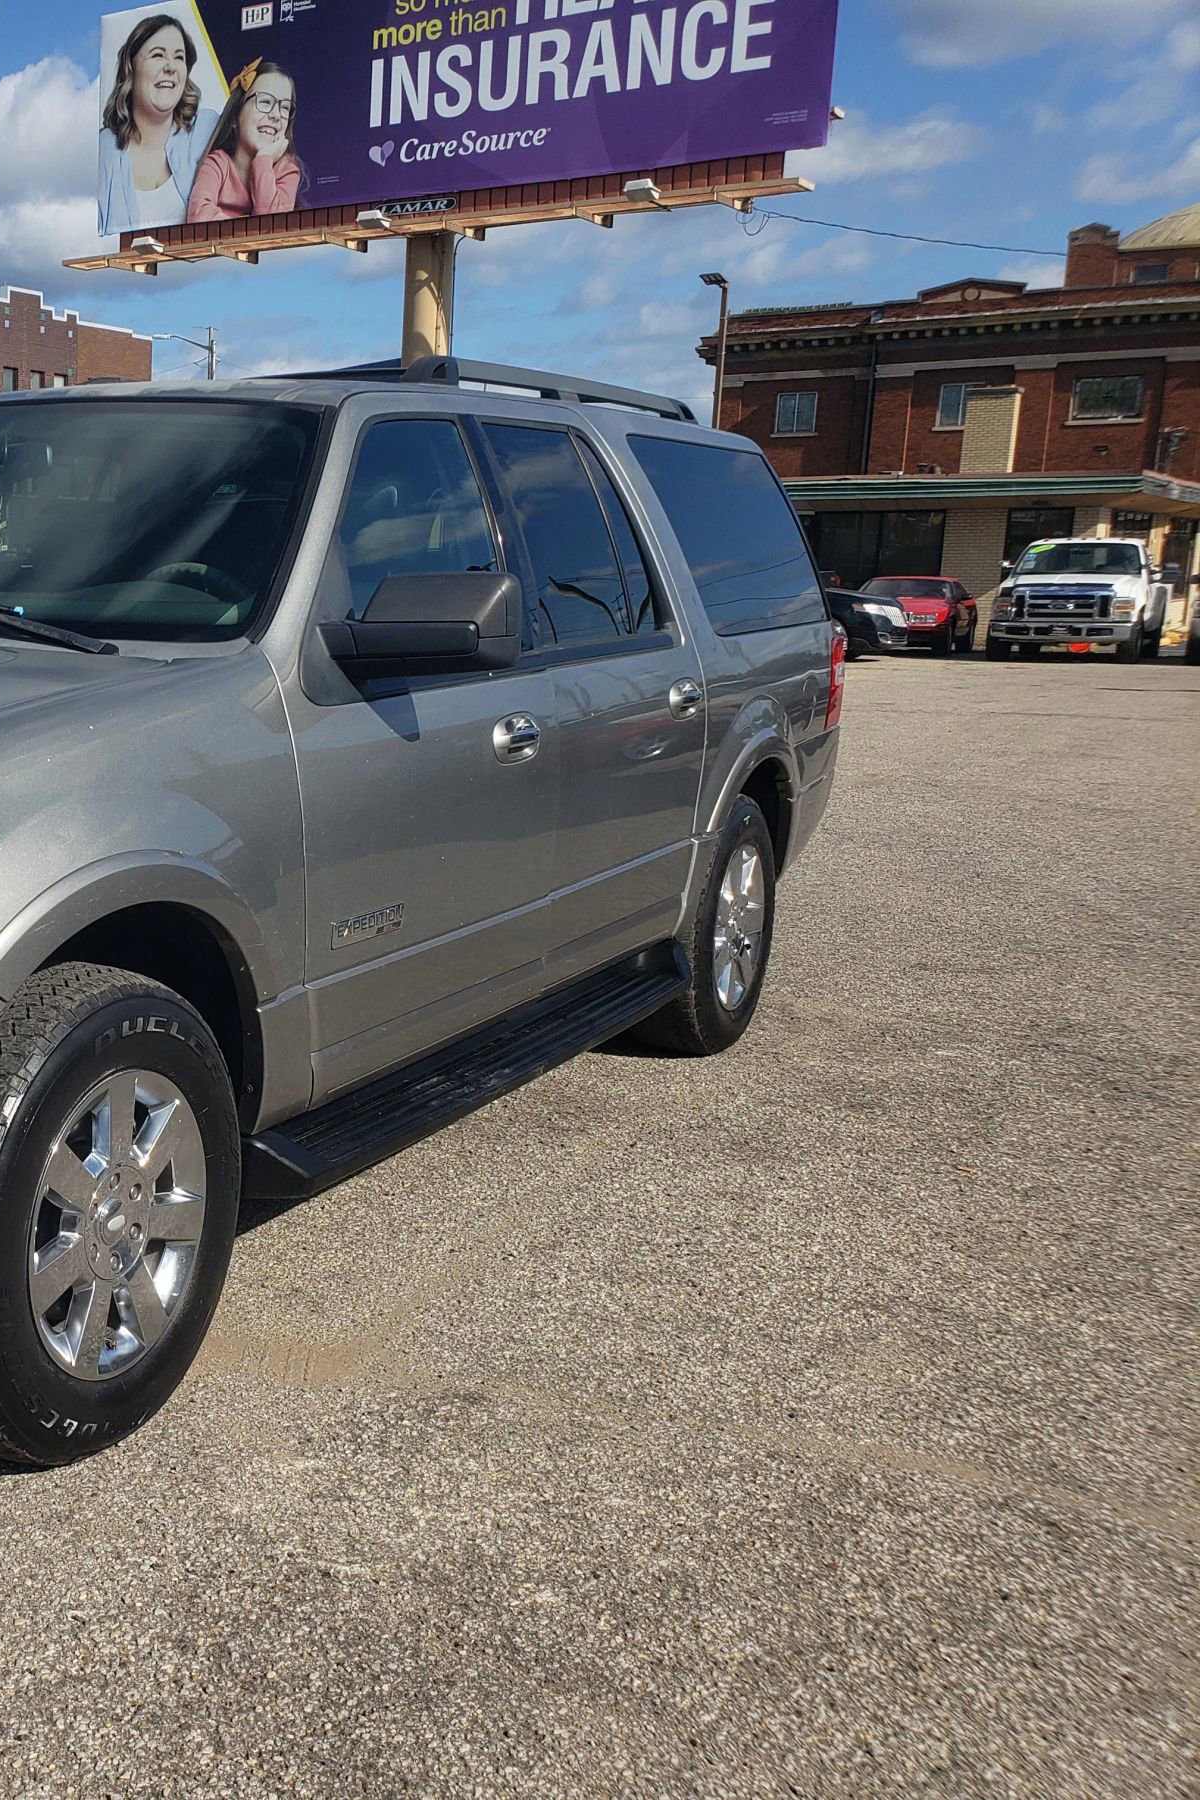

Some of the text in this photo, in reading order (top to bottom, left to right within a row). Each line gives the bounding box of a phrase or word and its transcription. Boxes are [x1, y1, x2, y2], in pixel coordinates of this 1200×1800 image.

[372, 18, 443, 50] more
[449, 7, 507, 37] than
[369, 0, 777, 128] INSURANCE
[380, 199, 448, 216] LAMAR
[337, 903, 404, 938] EXPEDITION
